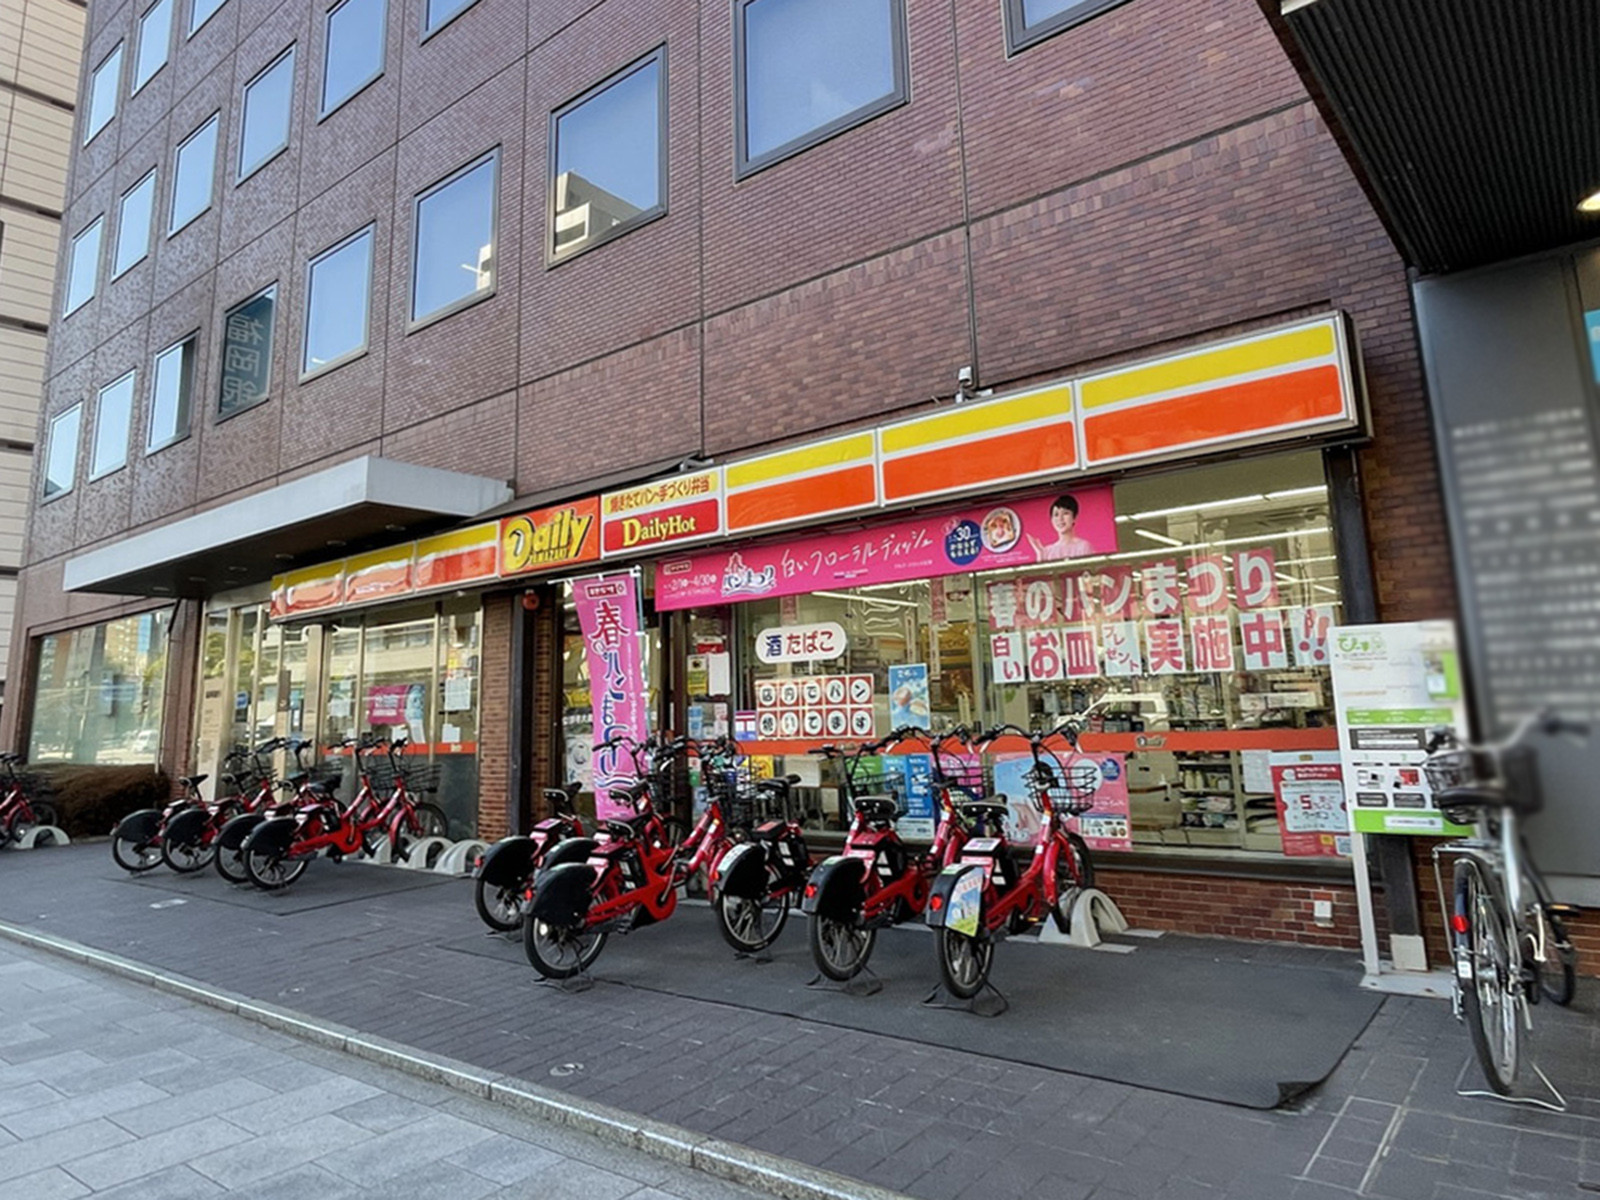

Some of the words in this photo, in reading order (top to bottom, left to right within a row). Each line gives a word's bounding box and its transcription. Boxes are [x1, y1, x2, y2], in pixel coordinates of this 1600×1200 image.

[503, 508, 594, 572] Daily
[622, 515, 696, 547] DailyHot
[781, 528, 934, 579] 白いフローラルディッシュ
[990, 552, 1272, 628] 春のパンまつり
[765, 634, 782, 657] 酒
[786, 630, 835, 654] たばこ
